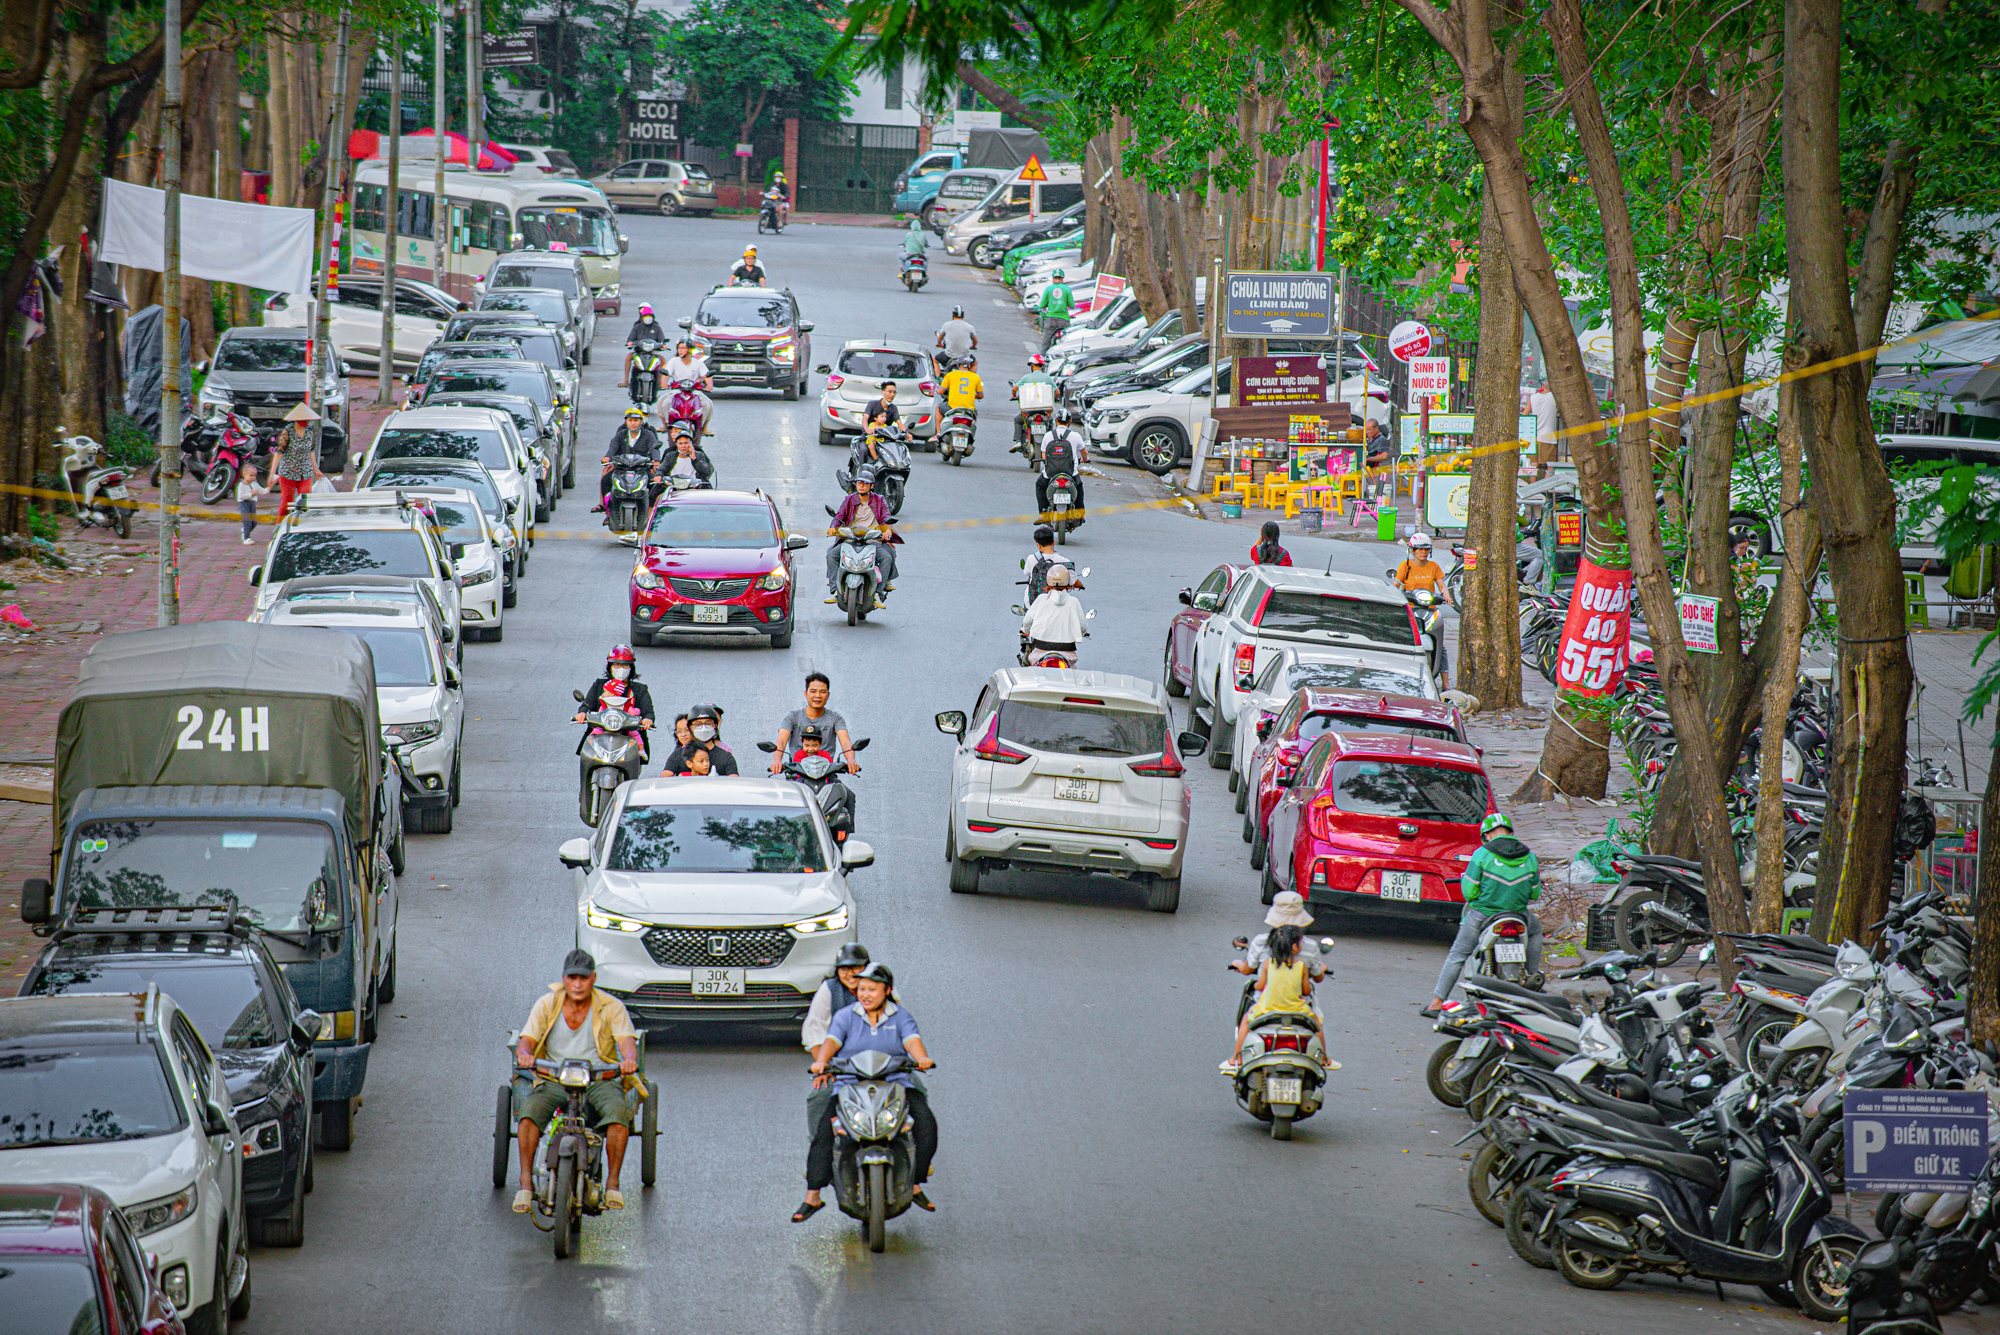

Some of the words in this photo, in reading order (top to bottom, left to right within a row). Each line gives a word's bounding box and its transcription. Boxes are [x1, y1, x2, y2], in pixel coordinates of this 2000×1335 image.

[506, 40, 528, 48] HOTEL
[638, 102, 669, 120] ECO
[630, 122, 678, 140] HOTEL
[1232, 278, 1260, 298] CHÙA
[1263, 282, 1288, 298] LINH
[1290, 279, 1326, 299] ĐƯỜNG
[1250, 300, 1278, 308] (LINH
[1280, 300, 1308, 310] ĐÀM)
[1414, 362, 1434, 373] SINH
[1436, 359, 1446, 373] TỐ
[959, 378, 969, 394] 2
[1246, 376, 1261, 386] CƠM
[1262, 376, 1278, 386] CHAY
[1280, 376, 1296, 387] THỰC
[1297, 375, 1320, 386] DƯỠNG
[1412, 376, 1434, 389] NƯỚC
[1437, 376, 1447, 389] ÉP
[1437, 420, 1450, 429] CÀ
[1452, 420, 1470, 429] PHÊ
[1683, 604, 1698, 622] BỌC
[1701, 602, 1716, 623] GHẾ
[1582, 614, 1617, 642] ÁO
[1561, 638, 1625, 690] 55K
[176, 705, 270, 752] 24H
[1068, 779, 1087, 790] 30H
[1392, 874, 1412, 886] 30F
[1383, 885, 1418, 899] 819.14
[1501, 945, 1521, 953] 19-F1
[1498, 953, 1524, 962] 356.61
[708, 970, 729, 980] 30K
[698, 982, 738, 993] 397.24
[1857, 1103, 1873, 1112] CÔNG
[1894, 1120, 1929, 1145] ĐIỂM
[1933, 1124, 1979, 1146] TRÔNG
[1853, 1120, 1886, 1173] P
[1914, 1153, 1939, 1175] GIỮ
[1941, 1157, 1960, 1176] XE
